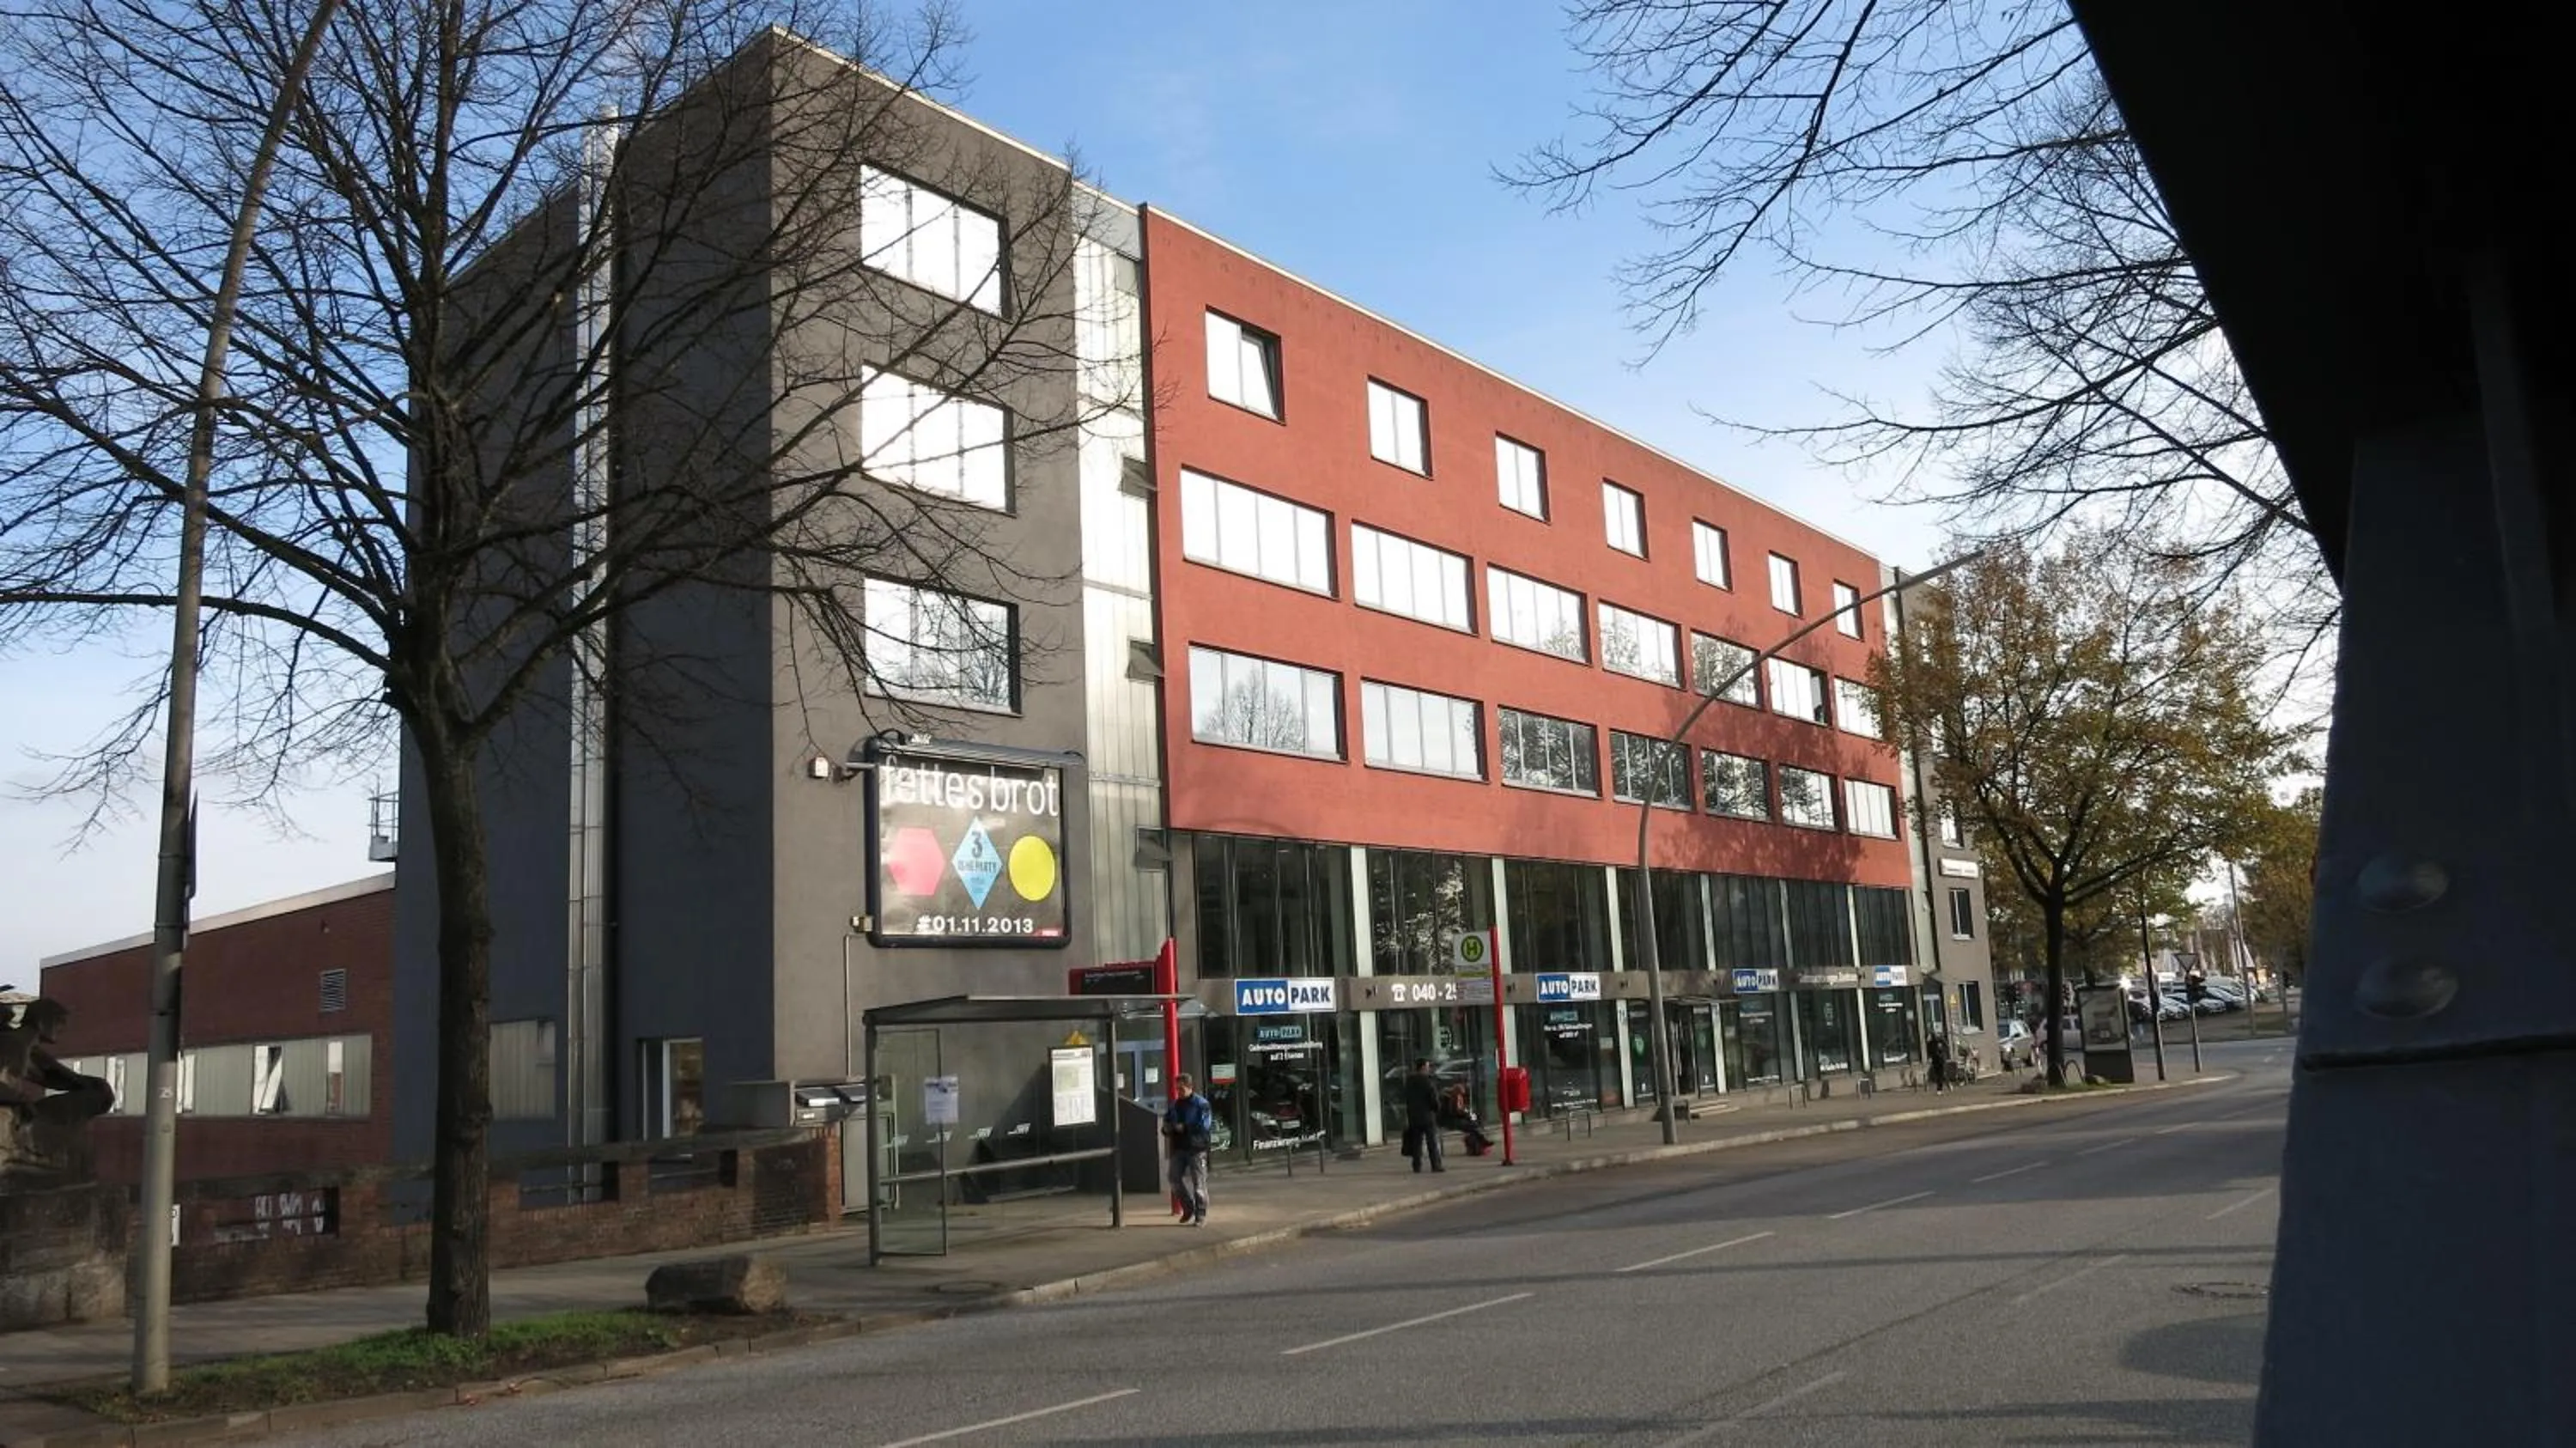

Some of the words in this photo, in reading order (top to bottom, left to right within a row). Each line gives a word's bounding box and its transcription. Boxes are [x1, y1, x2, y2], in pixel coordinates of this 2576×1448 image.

[971, 830, 983, 858] 3
[1242, 988, 1286, 1006] AUTO
[1291, 986, 1331, 1004] PARK
[1412, 983, 1436, 1001] 040
[1540, 979, 1569, 995] AUTO
[1571, 978, 1597, 994] PARK
